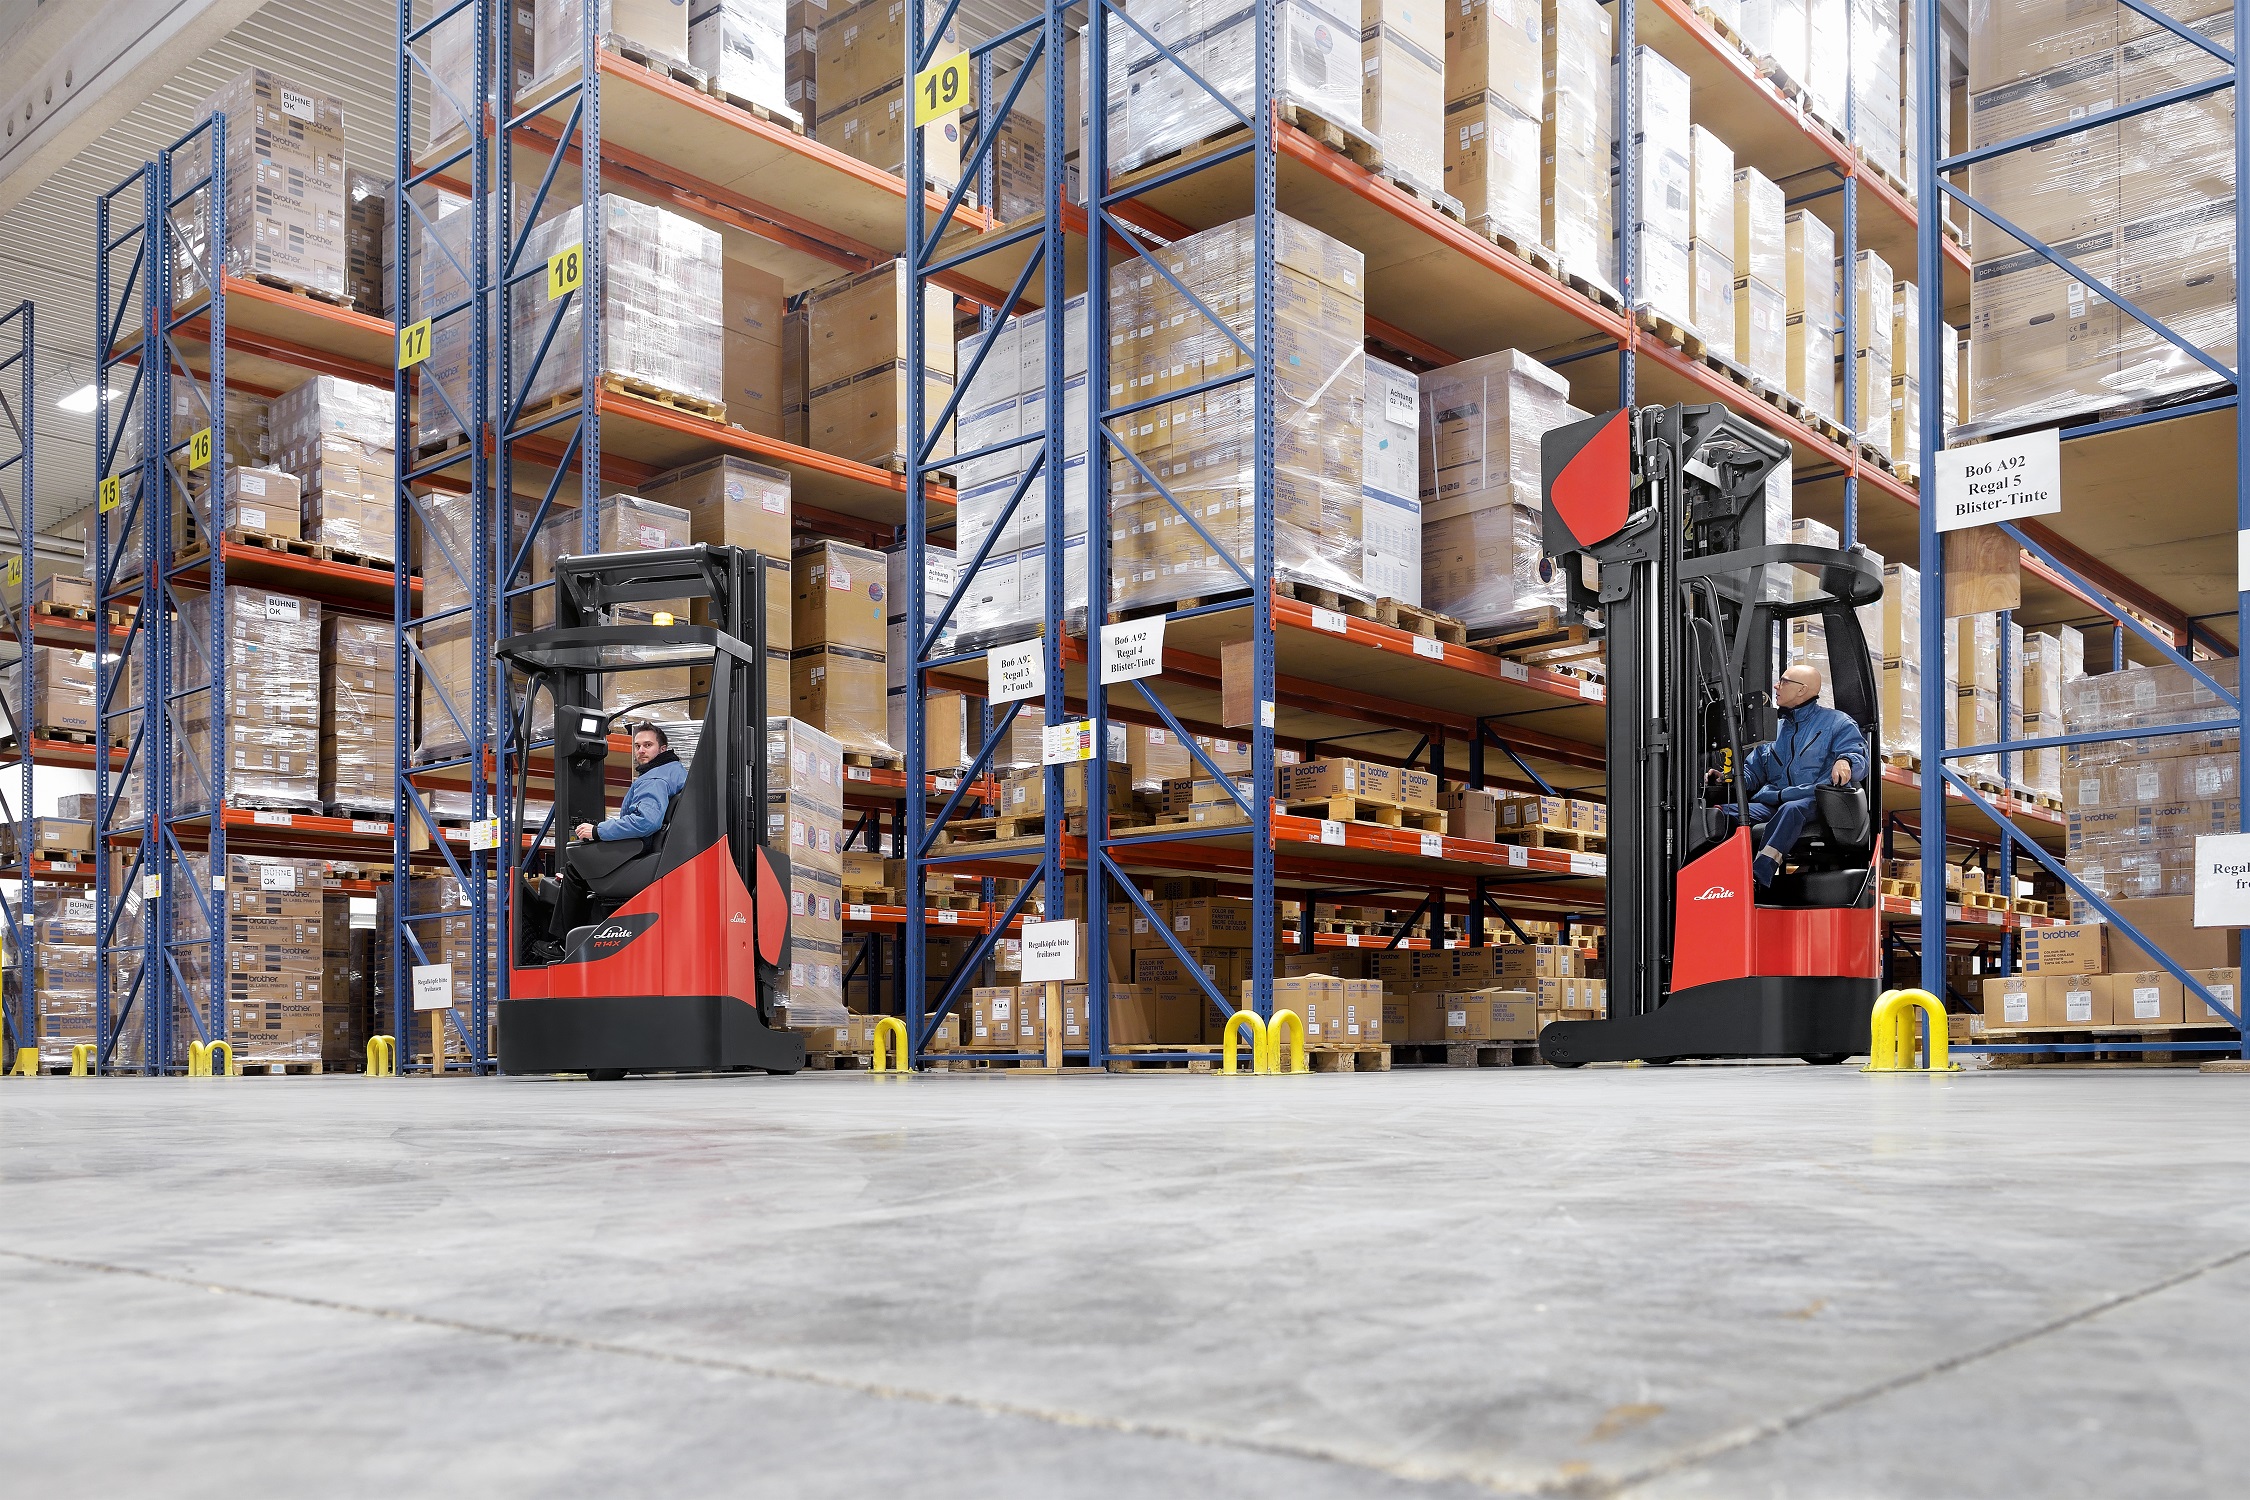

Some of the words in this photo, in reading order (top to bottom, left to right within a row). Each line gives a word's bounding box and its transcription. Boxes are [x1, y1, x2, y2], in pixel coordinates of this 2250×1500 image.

[925, 65, 959, 111] 19
[283, 102, 295, 110] OK
[272, 133, 300, 150] brother
[305, 174, 332, 189] brother
[272, 192, 302, 207] brother
[305, 231, 333, 246] brother
[2076, 239, 2107, 250] brother
[272, 248, 300, 263] brother
[555, 253, 578, 287] 18
[406, 326, 426, 358] 17
[1390, 388, 1413, 405] Achtung
[194, 434, 208, 461] 16
[1965, 461, 1992, 478] Bo6
[1997, 455, 2026, 472] A92
[1969, 476, 2008, 495] Regal
[2013, 474, 2022, 487] 5
[103, 481, 116, 505] 15
[1955, 490, 2048, 516] Blister-Tinte
[10, 562, 21, 579] 14
[928, 569, 949, 579] Achtung
[1114, 635, 1129, 646] Bo6
[1130, 632, 1147, 642] A92
[1116, 646, 1137, 659] Regal
[1138, 645, 1143, 653] 4
[1001, 657, 1015, 669] Bo6
[1017, 654, 1031, 666] A92
[1111, 658, 1156, 673] Blister-Tinte
[1003, 669, 1024, 681] Regal
[1025, 668, 1030, 677] 3
[1002, 680, 1033, 693] P-Touch
[63, 716, 87, 725] brother
[1295, 765, 1327, 776] brother
[1368, 766, 1389, 778] brother
[1174, 780, 1192, 790] brot
[1408, 774, 1429, 785] brother
[2155, 806, 2190, 816] brother
[2229, 802, 2240, 811] bro
[2085, 813, 2117, 822] brother
[2213, 862, 2250, 876] Regal
[282, 890, 311, 898] brother
[1693, 886, 1735, 901] Linde
[730, 911, 747, 924] Linde
[594, 926, 632, 939] Linde
[2042, 930, 2080, 940] brother
[1028, 940, 1057, 949] Regalköpfe
[1057, 938, 1070, 947] bitte
[65, 970, 94, 978] brother
